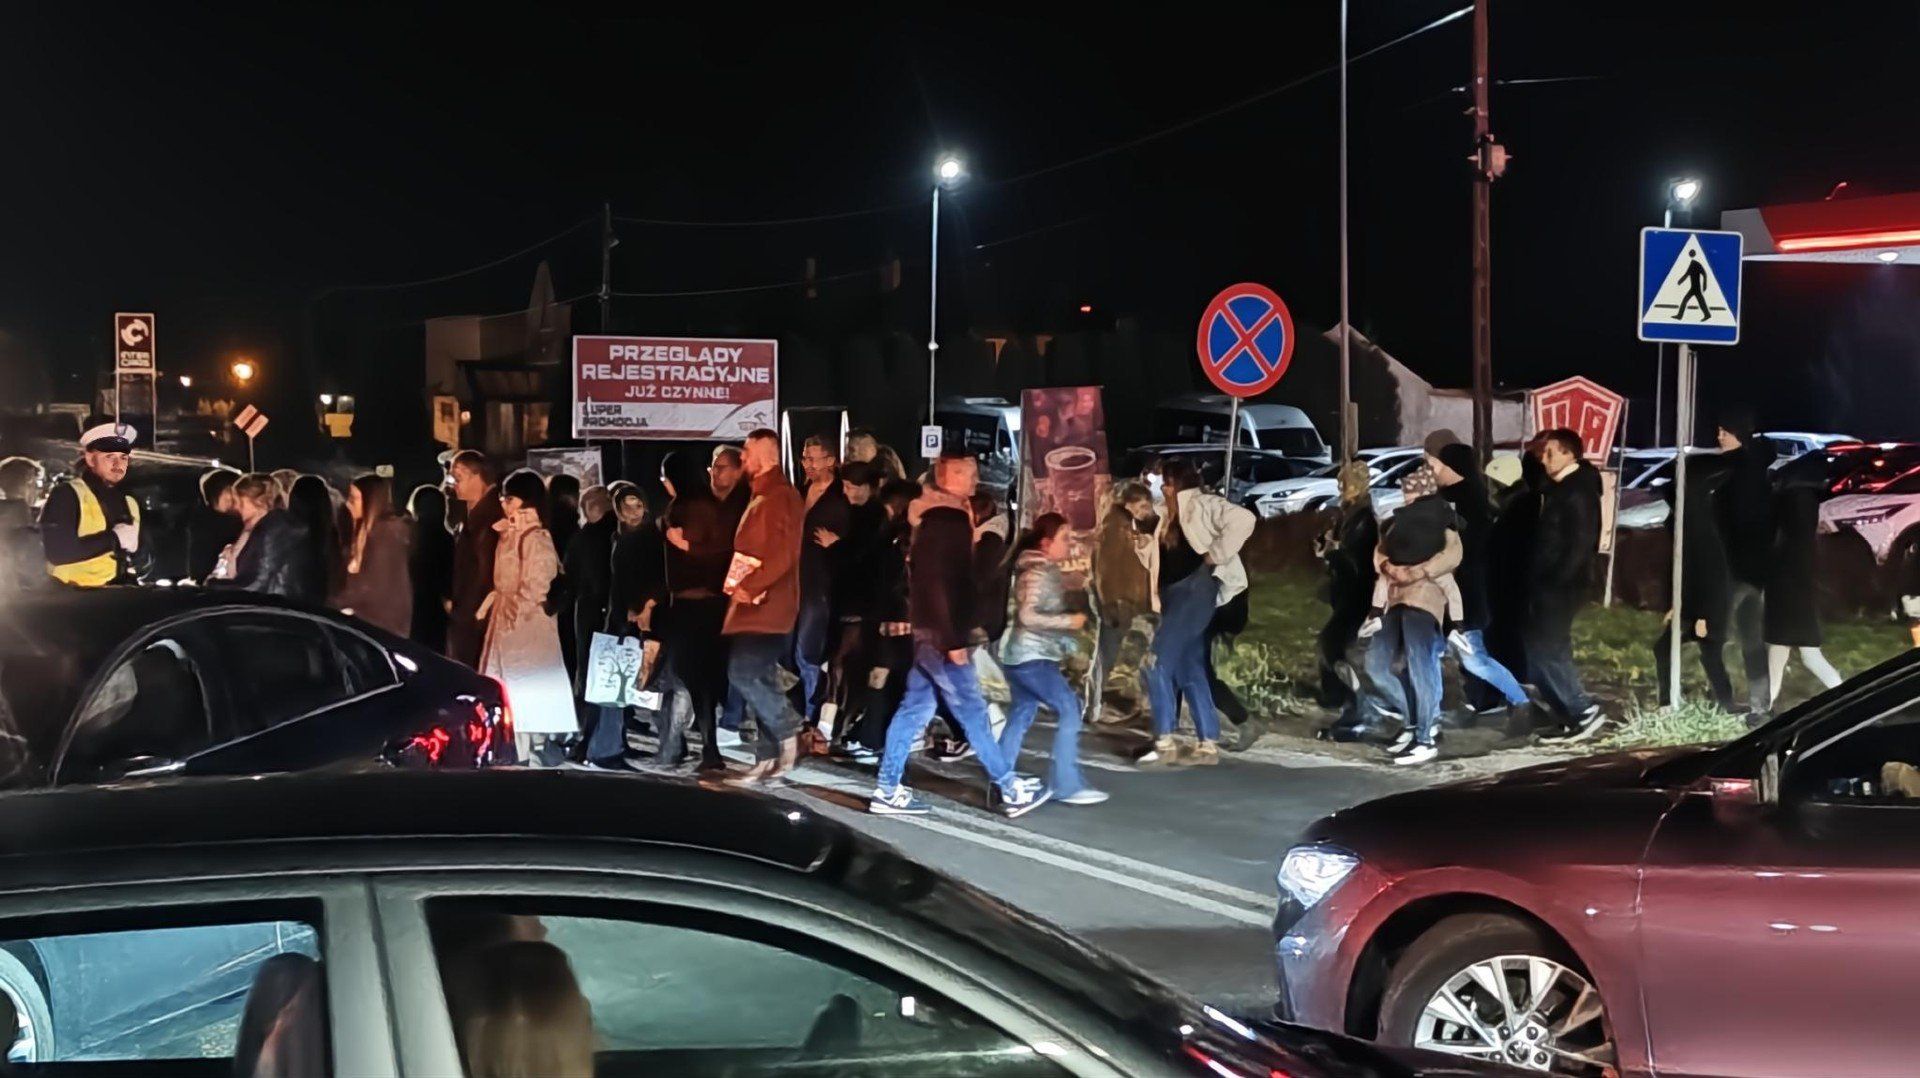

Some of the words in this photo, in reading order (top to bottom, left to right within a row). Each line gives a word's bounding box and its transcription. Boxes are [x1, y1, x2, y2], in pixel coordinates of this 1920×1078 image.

[609, 345, 742, 366] PRZEGLĄDY
[581, 363, 770, 383] REJESTRACYJNE
[624, 384, 656, 398] JUŻ
[661, 386, 730, 399] CZYNNE!
